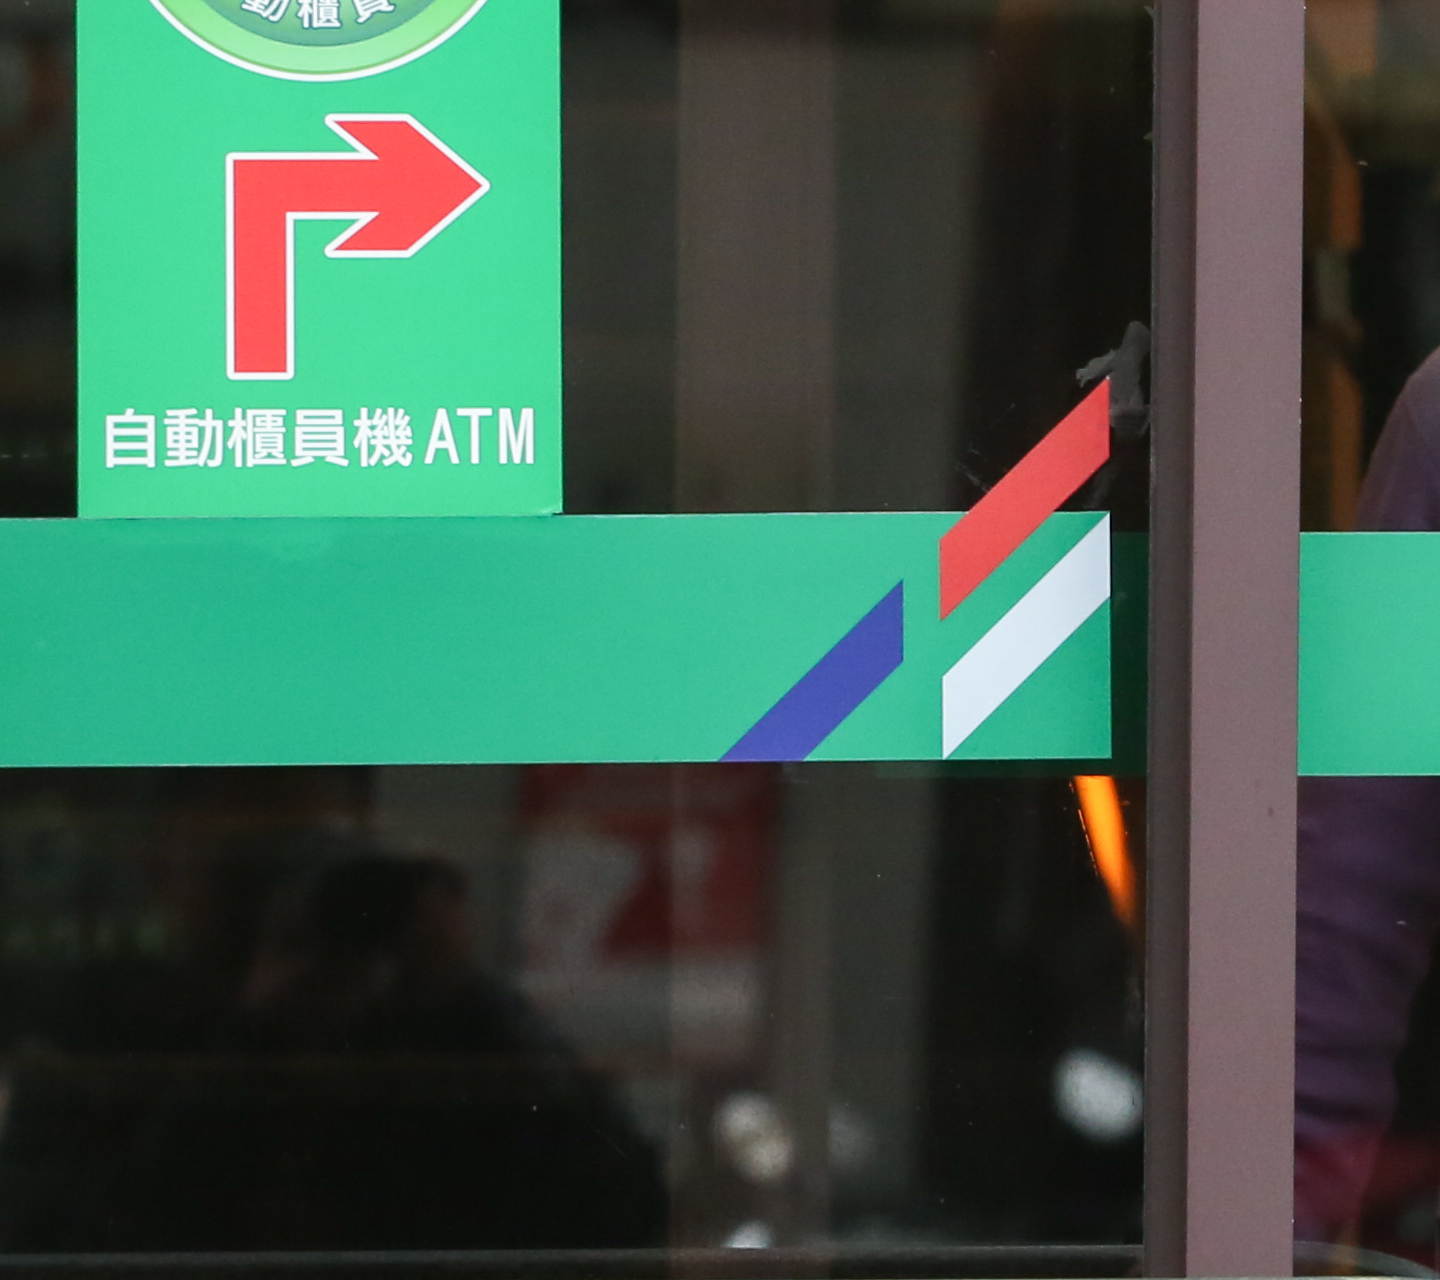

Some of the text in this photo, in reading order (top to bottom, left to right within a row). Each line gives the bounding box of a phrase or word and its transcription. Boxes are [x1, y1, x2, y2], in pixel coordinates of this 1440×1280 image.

[104, 406, 536, 470] 自動櫃員機 ATM
